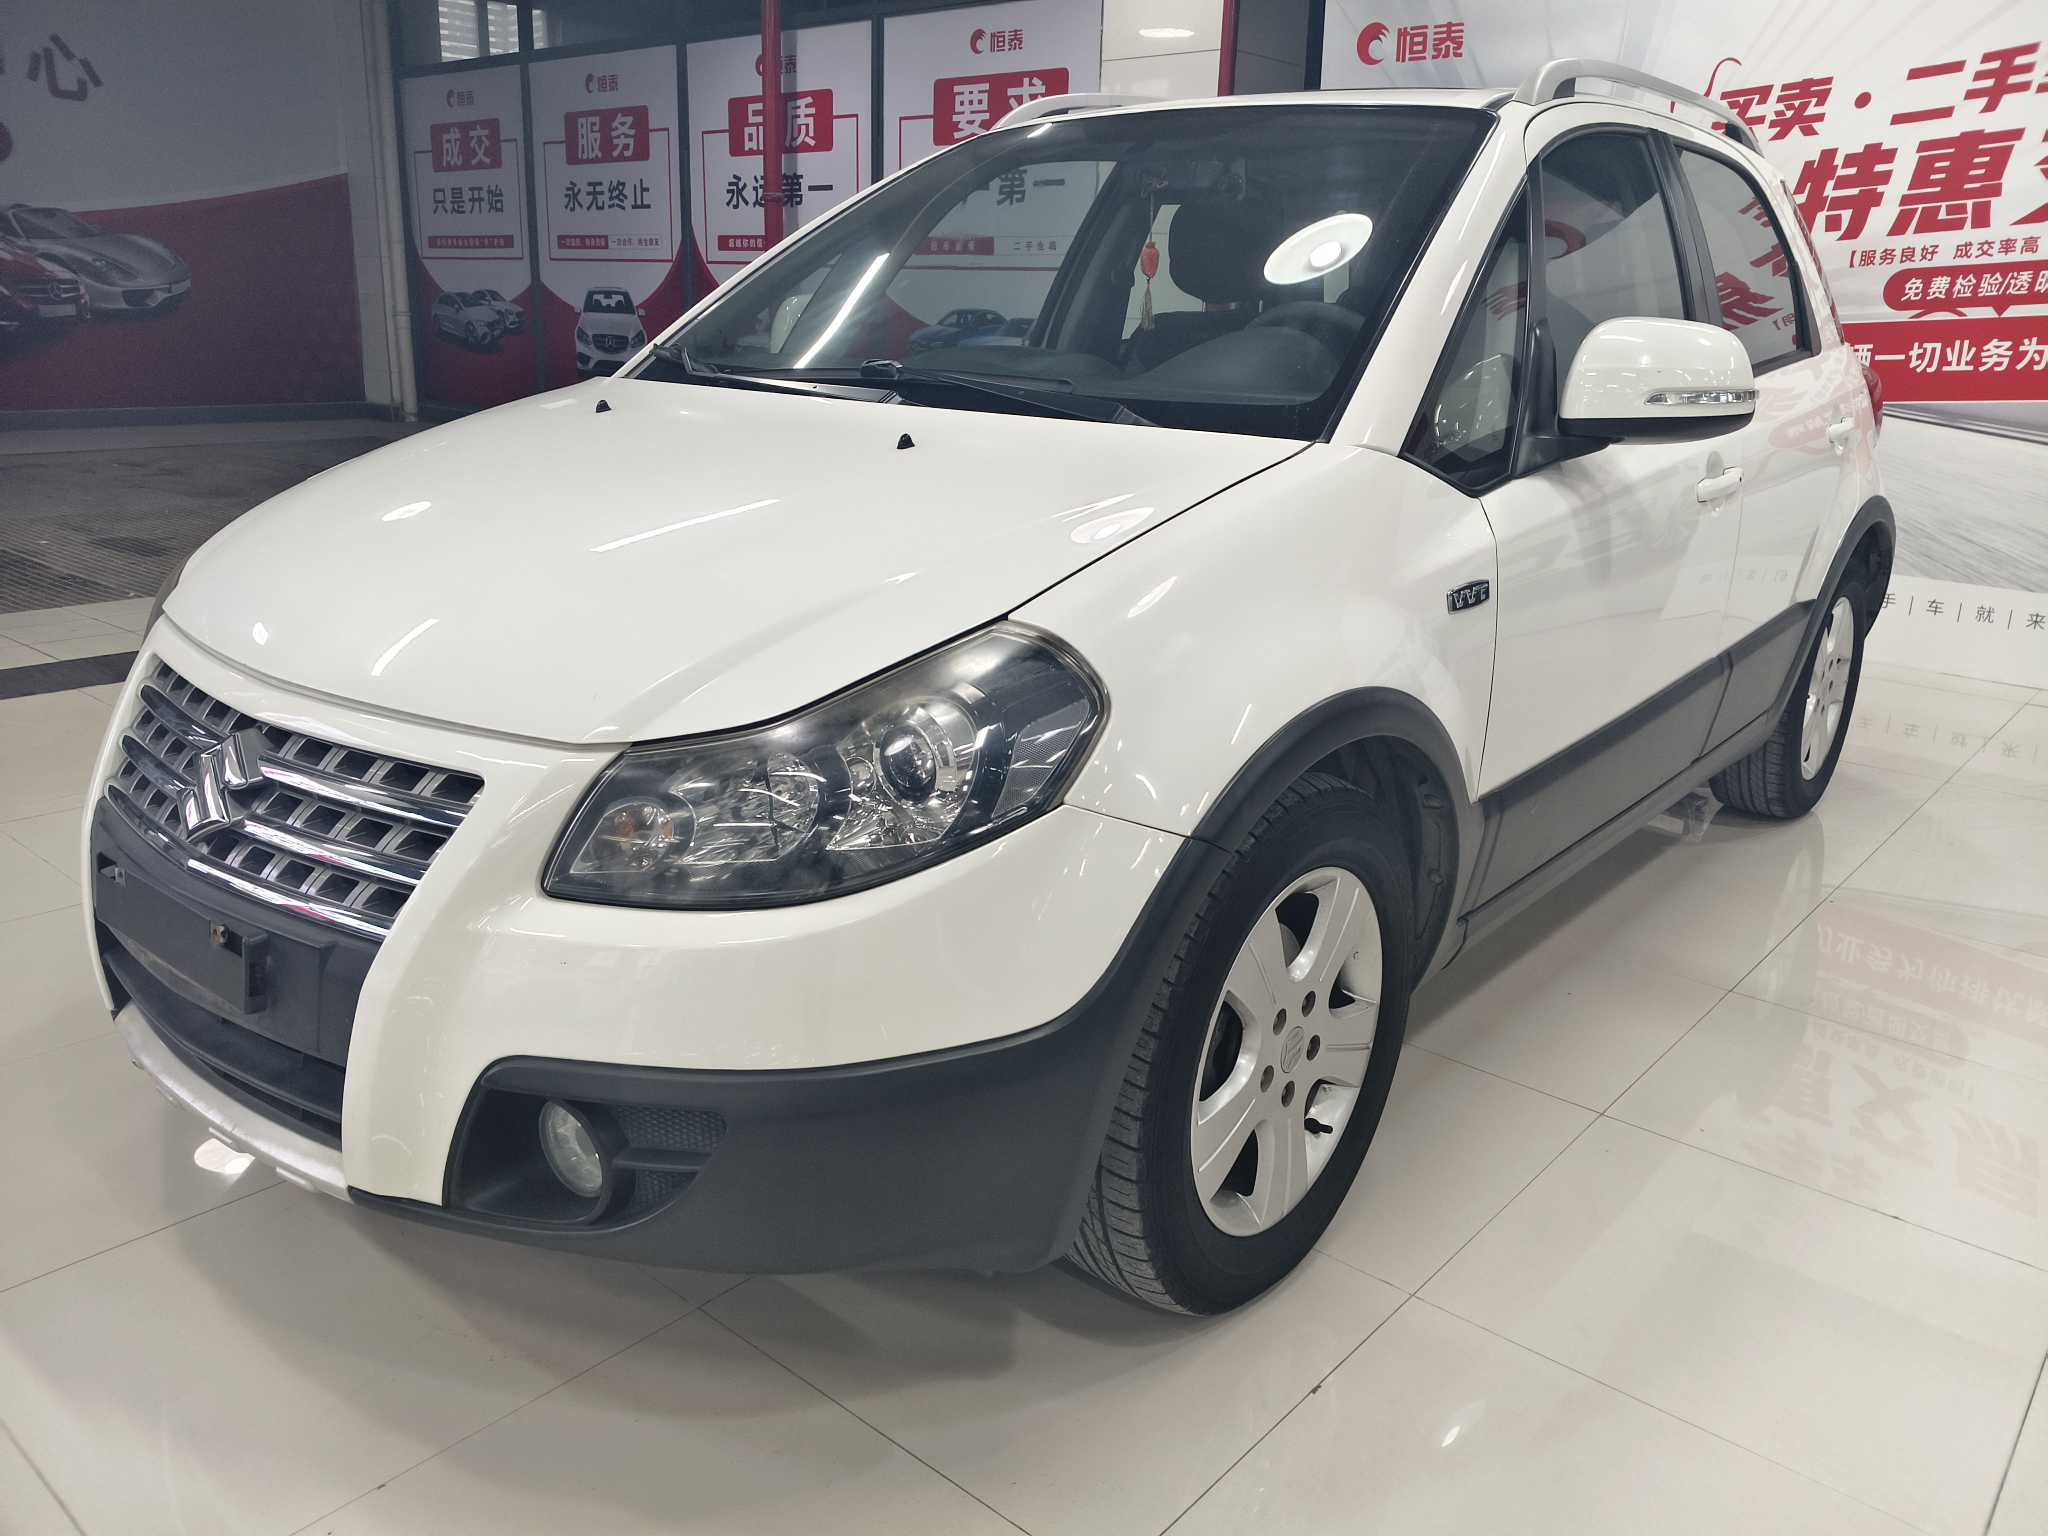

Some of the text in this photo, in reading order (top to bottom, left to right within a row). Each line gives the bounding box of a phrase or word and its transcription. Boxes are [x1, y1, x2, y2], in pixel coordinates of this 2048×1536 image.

[990, 29, 1024, 53] 恒泰
[1395, 22, 1464, 62] 恒泰
[0, 33, 104, 101] 心
[952, 76, 1046, 140] 要求
[442, 125, 491, 168] 成交
[577, 112, 636, 160] 服务
[432, 184, 504, 215] 只是开始
[564, 178, 652, 213] 永无终止
[1953, 236, 2041, 260] 成交率高
